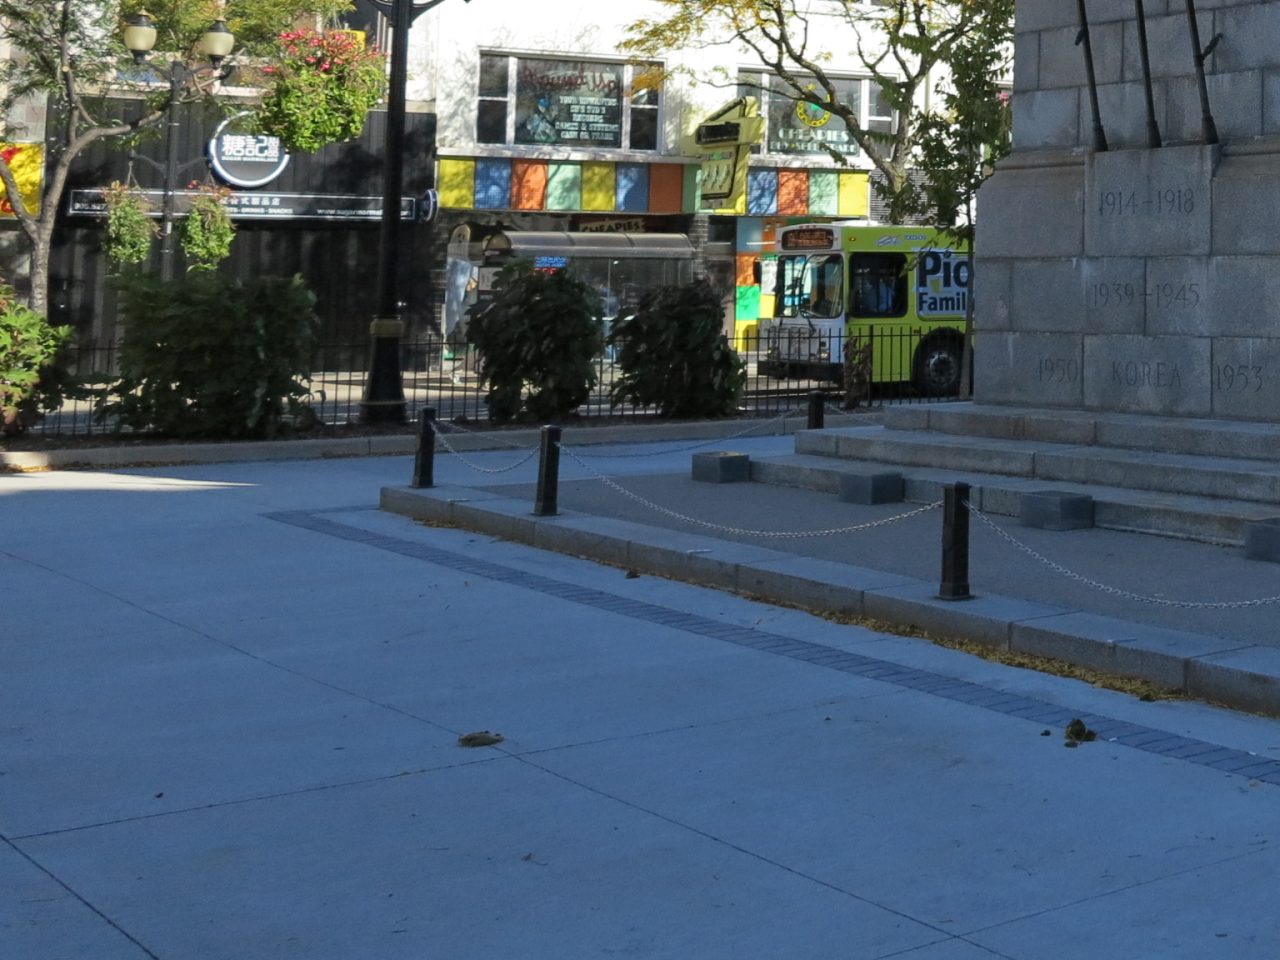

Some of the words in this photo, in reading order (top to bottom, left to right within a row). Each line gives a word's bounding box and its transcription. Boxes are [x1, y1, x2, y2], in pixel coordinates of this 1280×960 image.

[778, 128, 849, 142] CHEAPIES
[919, 251, 968, 288] Pio
[919, 291, 966, 312] Famil
[1038, 357, 1078, 383] 1950
[1111, 360, 1182, 388] KOREA
[1215, 362, 1264, 393] 1953
